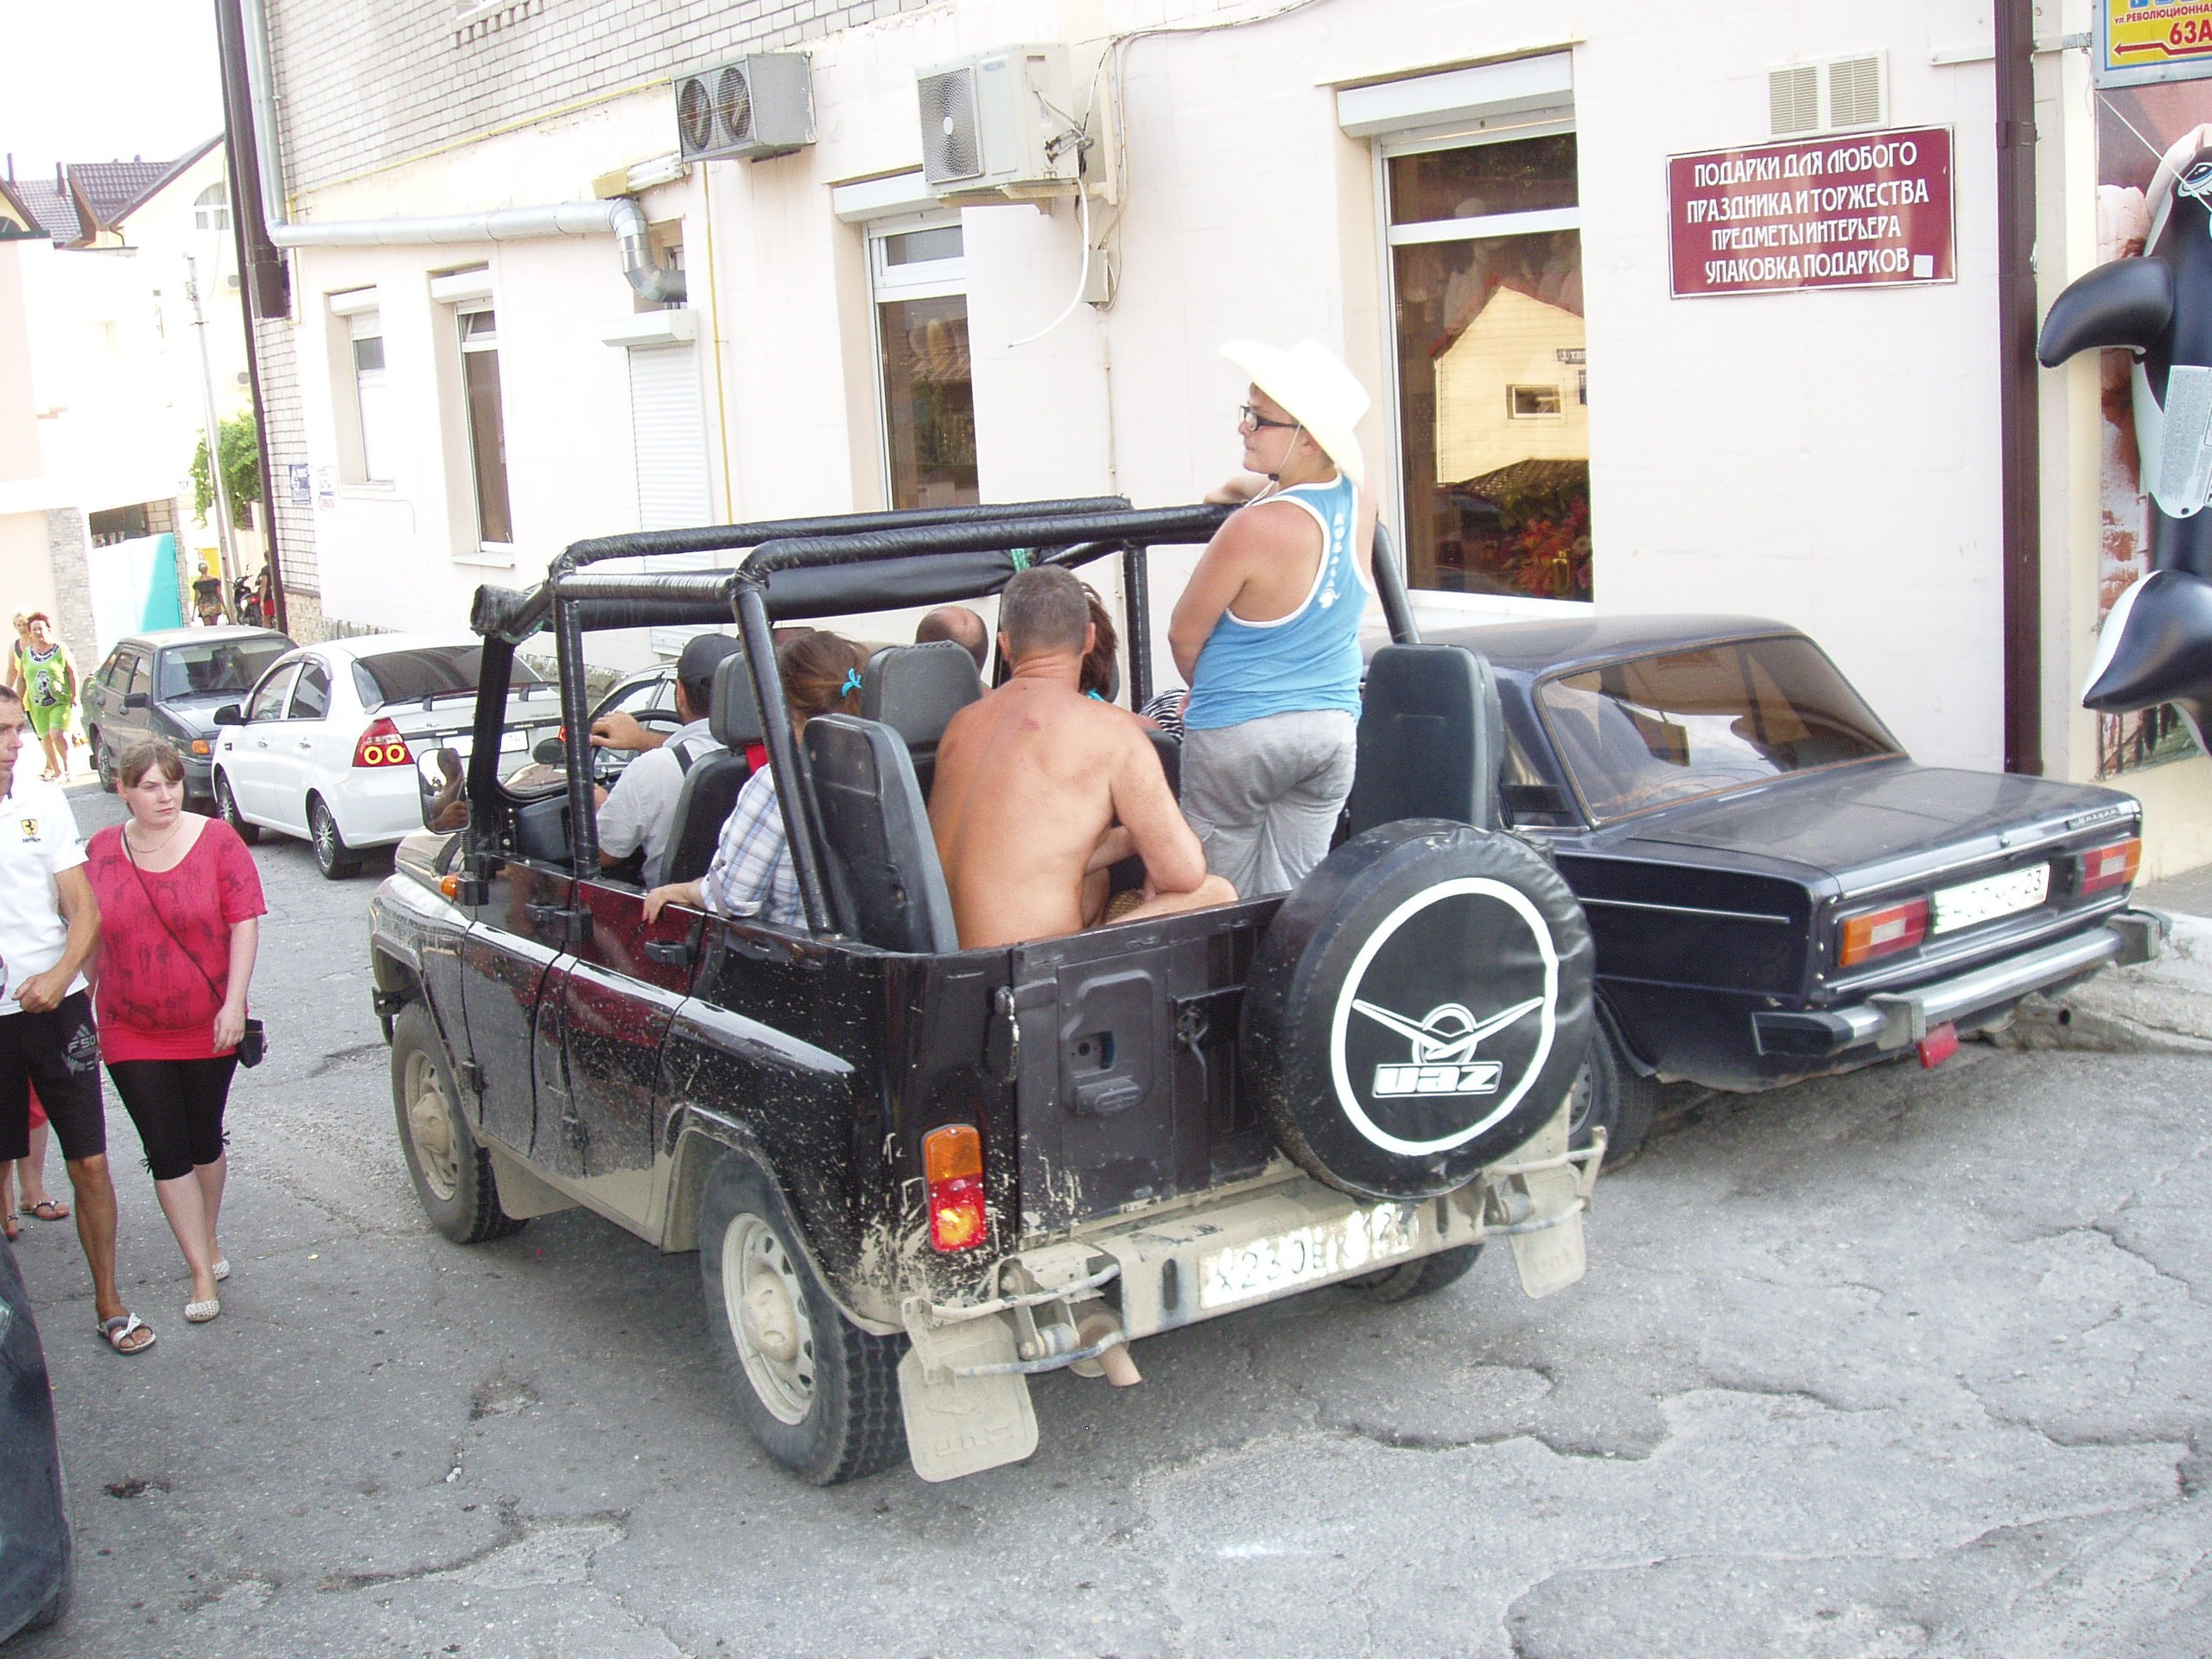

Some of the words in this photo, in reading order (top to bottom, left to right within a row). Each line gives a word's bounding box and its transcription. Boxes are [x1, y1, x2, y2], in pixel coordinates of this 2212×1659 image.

[2114, 3, 2212, 24] ул.РЕВОЛЮЦИОННА
[2170, 19, 2212, 45] 63А
[1694, 154, 1780, 188] ПОДАРКИ
[1783, 151, 1823, 178] ДЛЯ
[1827, 142, 1917, 174] ЛЮБОГО
[1687, 191, 1793, 224] ПРАЗДНИКА
[1796, 191, 1808, 214] И
[1811, 178, 1929, 211] ТОРЖЕСТВА
[1712, 223, 1804, 251] ПРЕДМЕТЫ
[1807, 215, 1902, 245] ИНТЕРЬЕРА
[1705, 256, 1801, 284] УПАКОВКА
[1803, 247, 1910, 278] ПОДАРКОВ
